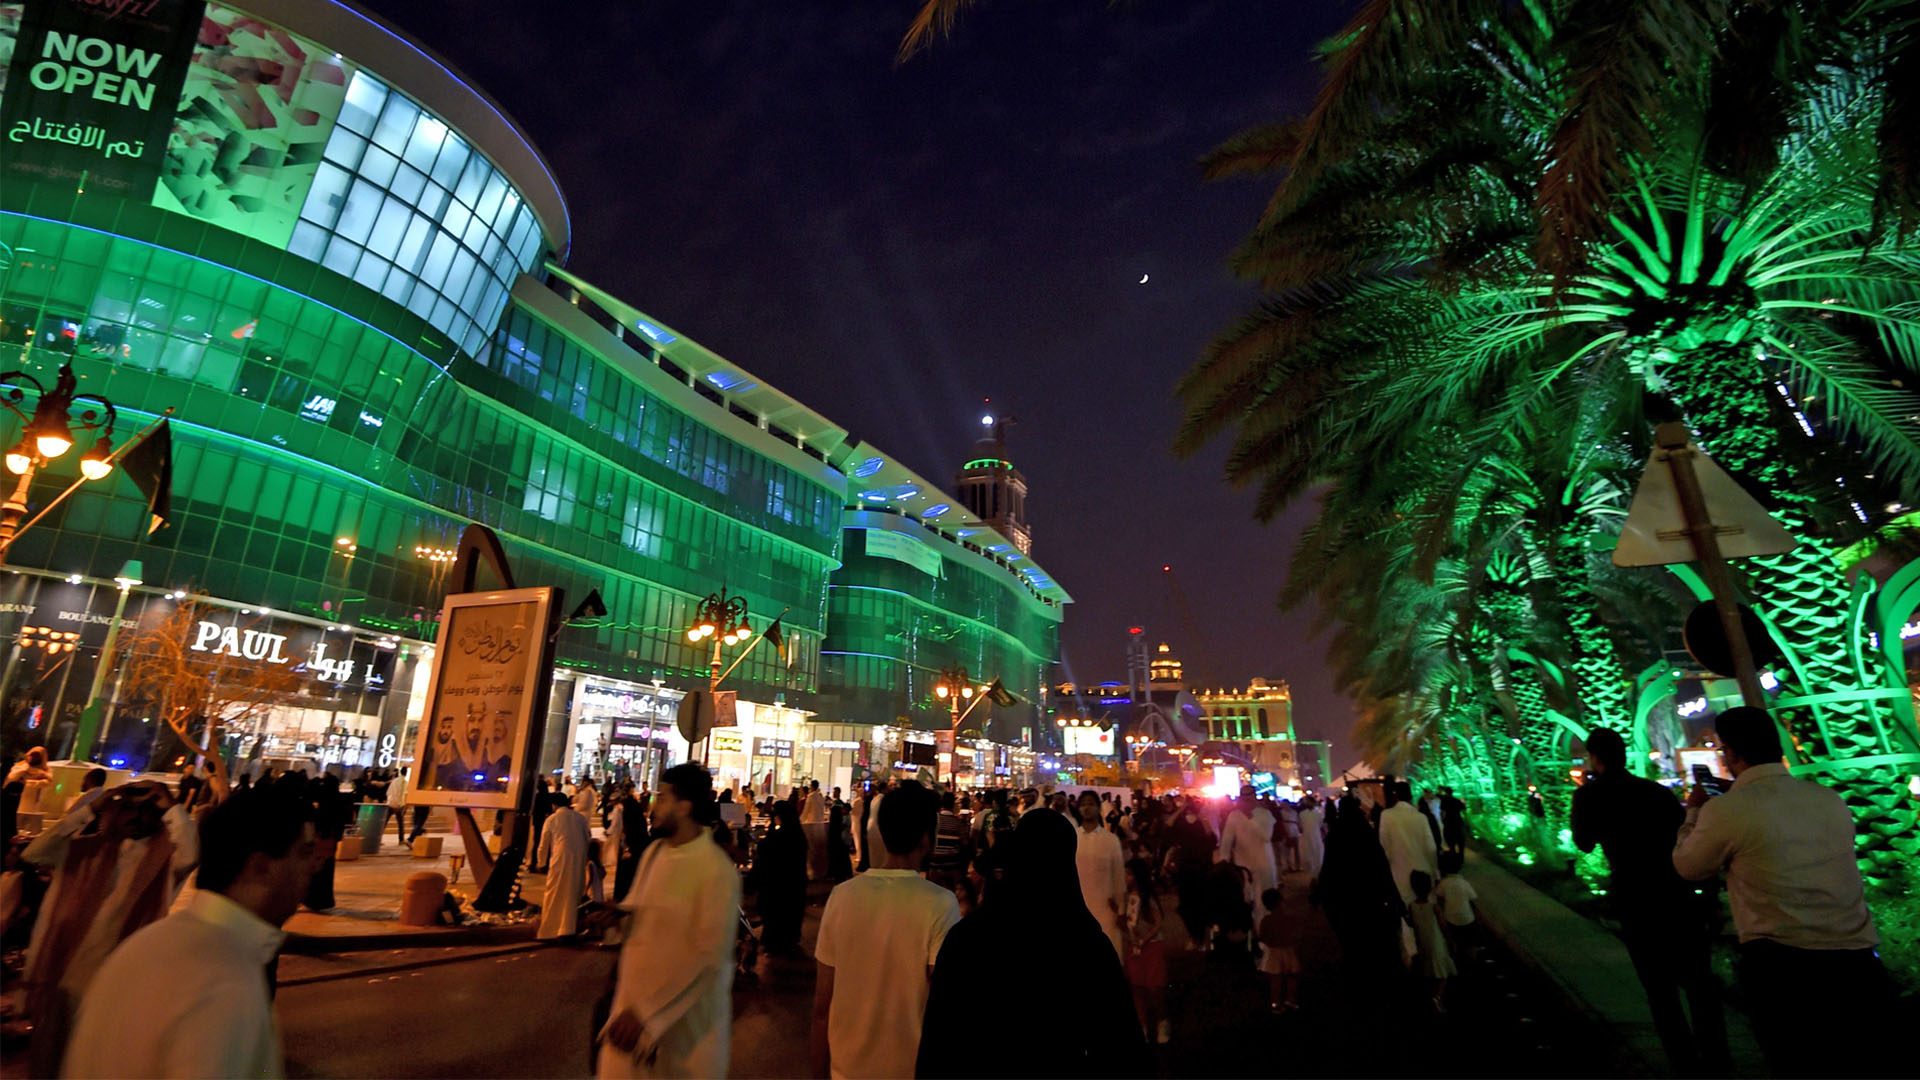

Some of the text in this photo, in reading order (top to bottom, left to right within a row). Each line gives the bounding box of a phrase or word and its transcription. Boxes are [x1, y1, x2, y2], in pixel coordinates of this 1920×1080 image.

[41, 30, 163, 79] NOW
[29, 61, 156, 111] OPEN
[8, 116, 145, 159] تم الافتتاح
[58, 610, 138, 631] BOULANGRIE
[191, 621, 289, 664] PAUL
